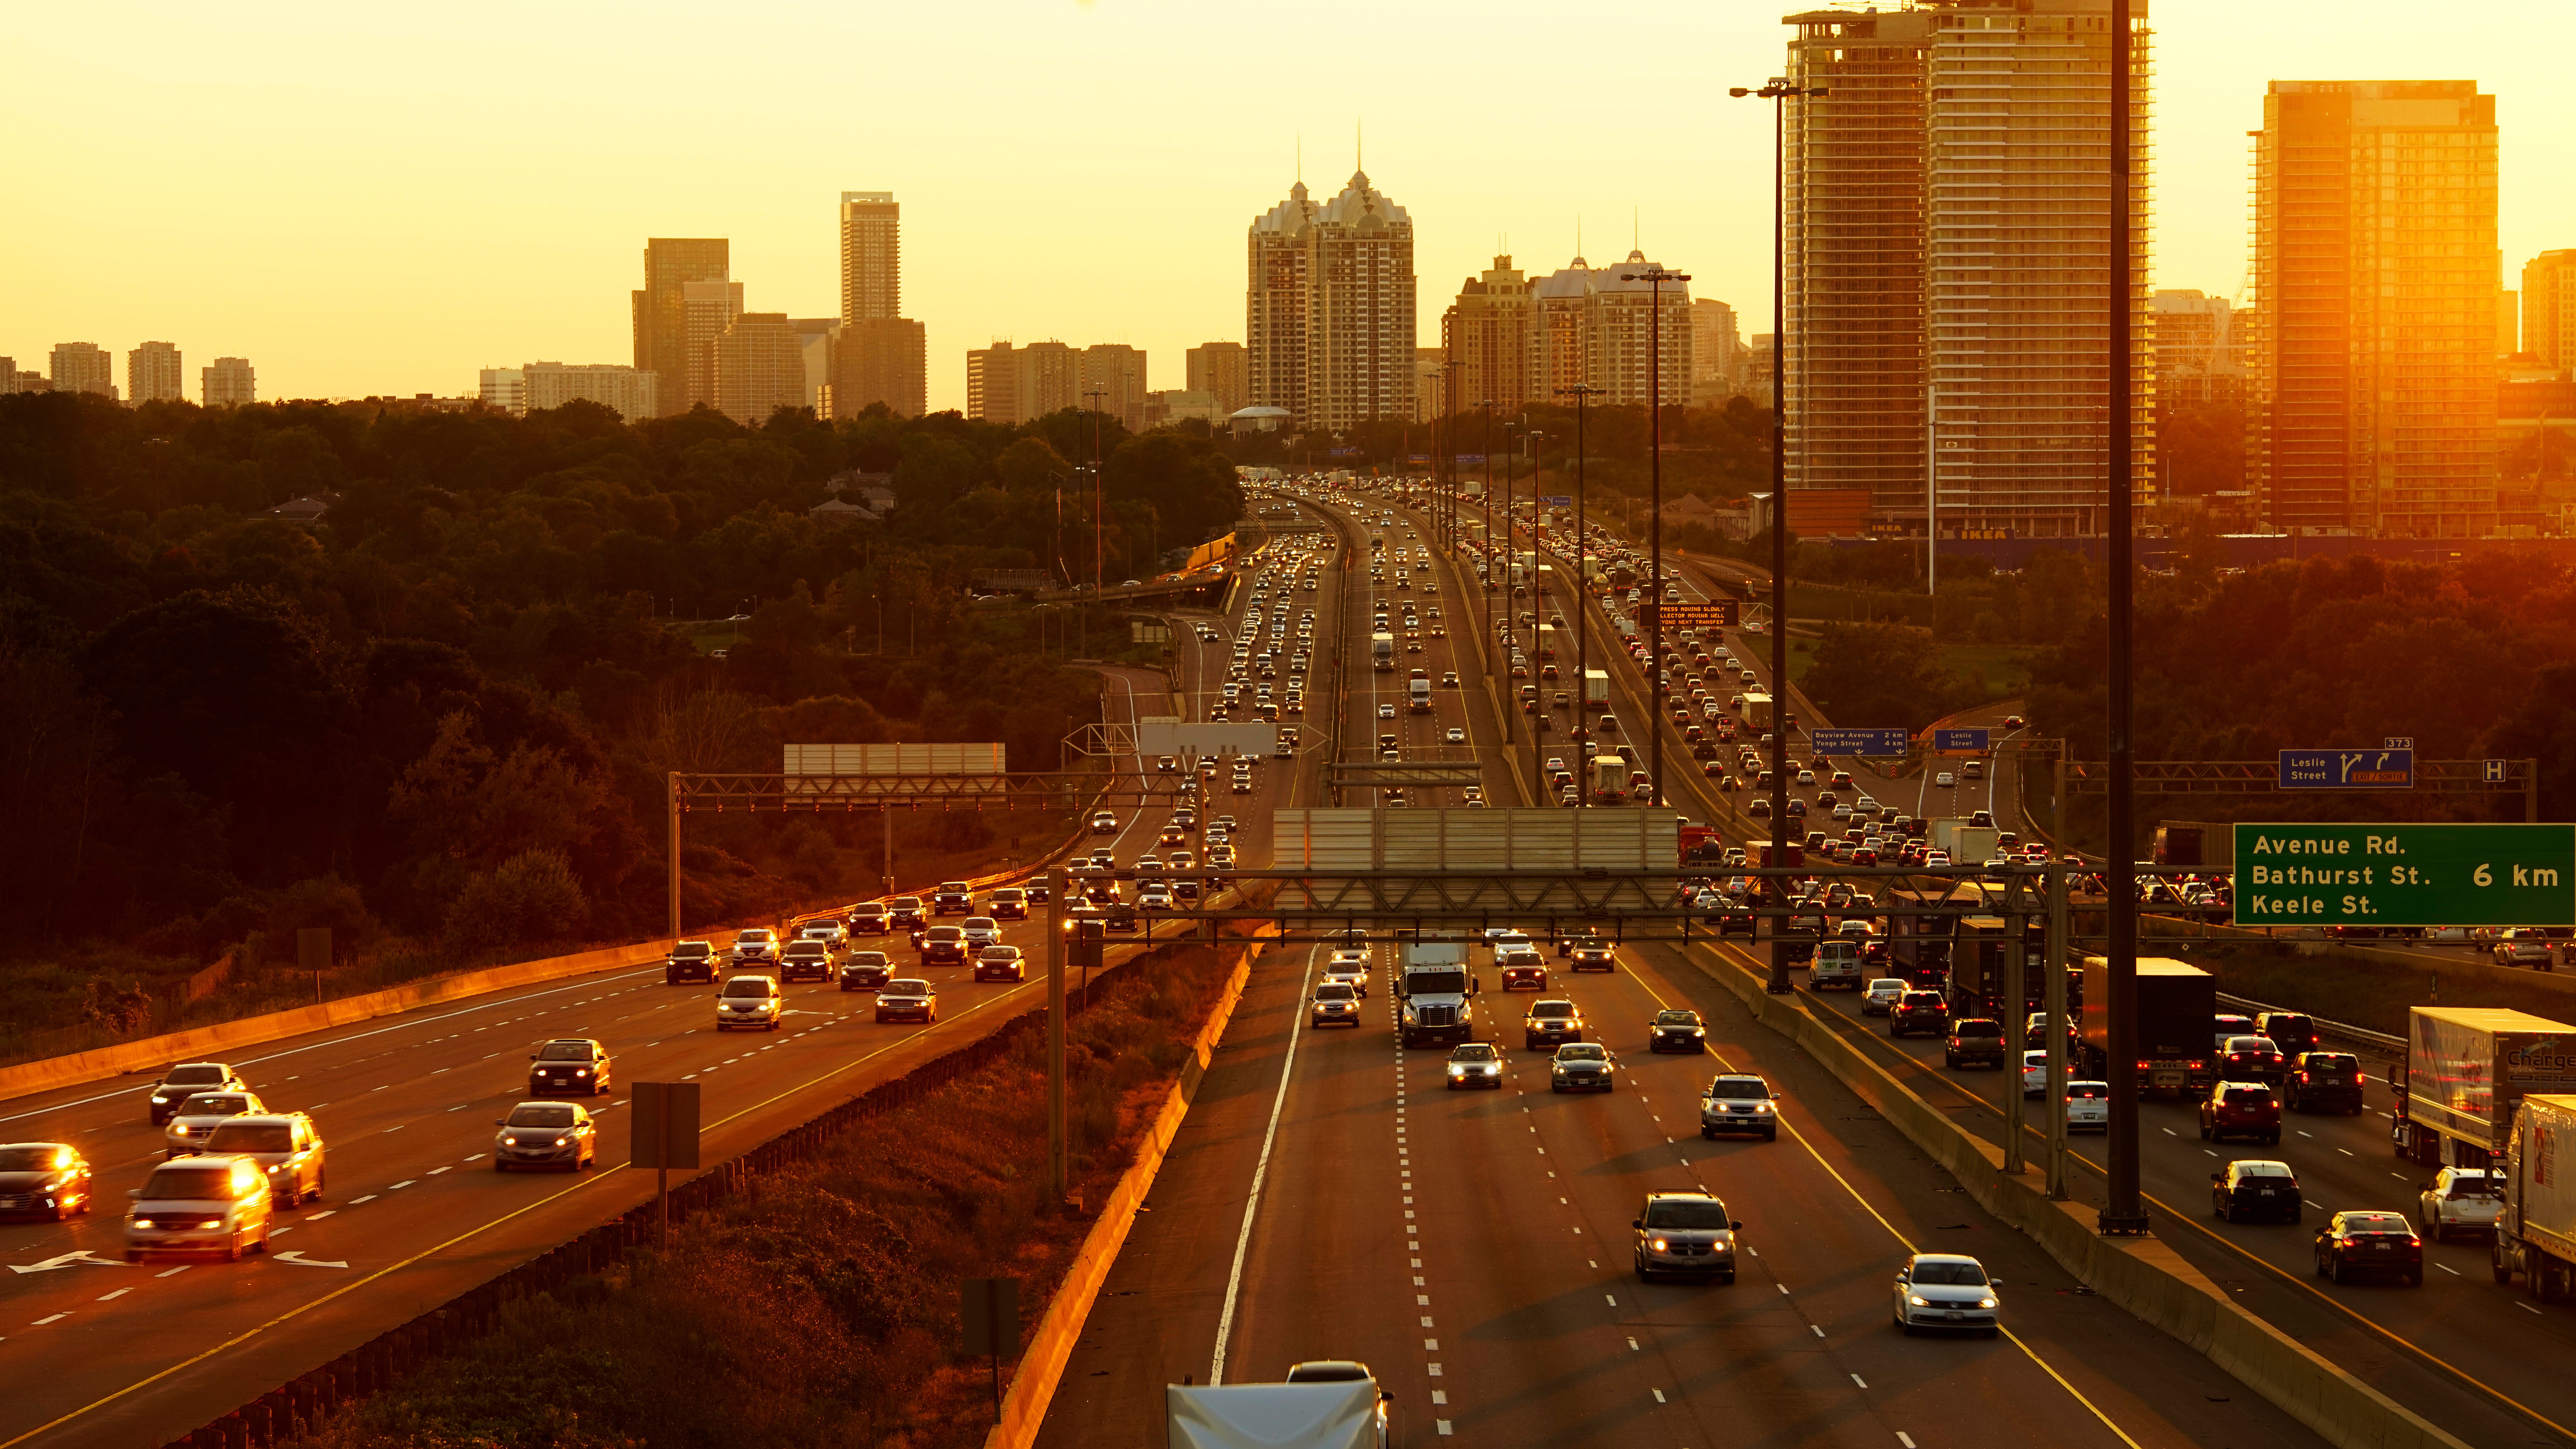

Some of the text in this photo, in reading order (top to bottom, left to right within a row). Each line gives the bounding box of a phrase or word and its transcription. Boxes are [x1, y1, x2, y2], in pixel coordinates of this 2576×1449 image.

[1962, 530, 2006, 539] IKEA
[2388, 739, 2411, 748] 373
[2292, 758, 2325, 767] Leslie
[2291, 771, 2326, 779] Street
[2487, 762, 2502, 779] H
[2253, 836, 2405, 854] Avenue Rd.
[2253, 863, 2558, 887] Bathurst St. 6 km
[2253, 895, 2377, 914] Keele St.
